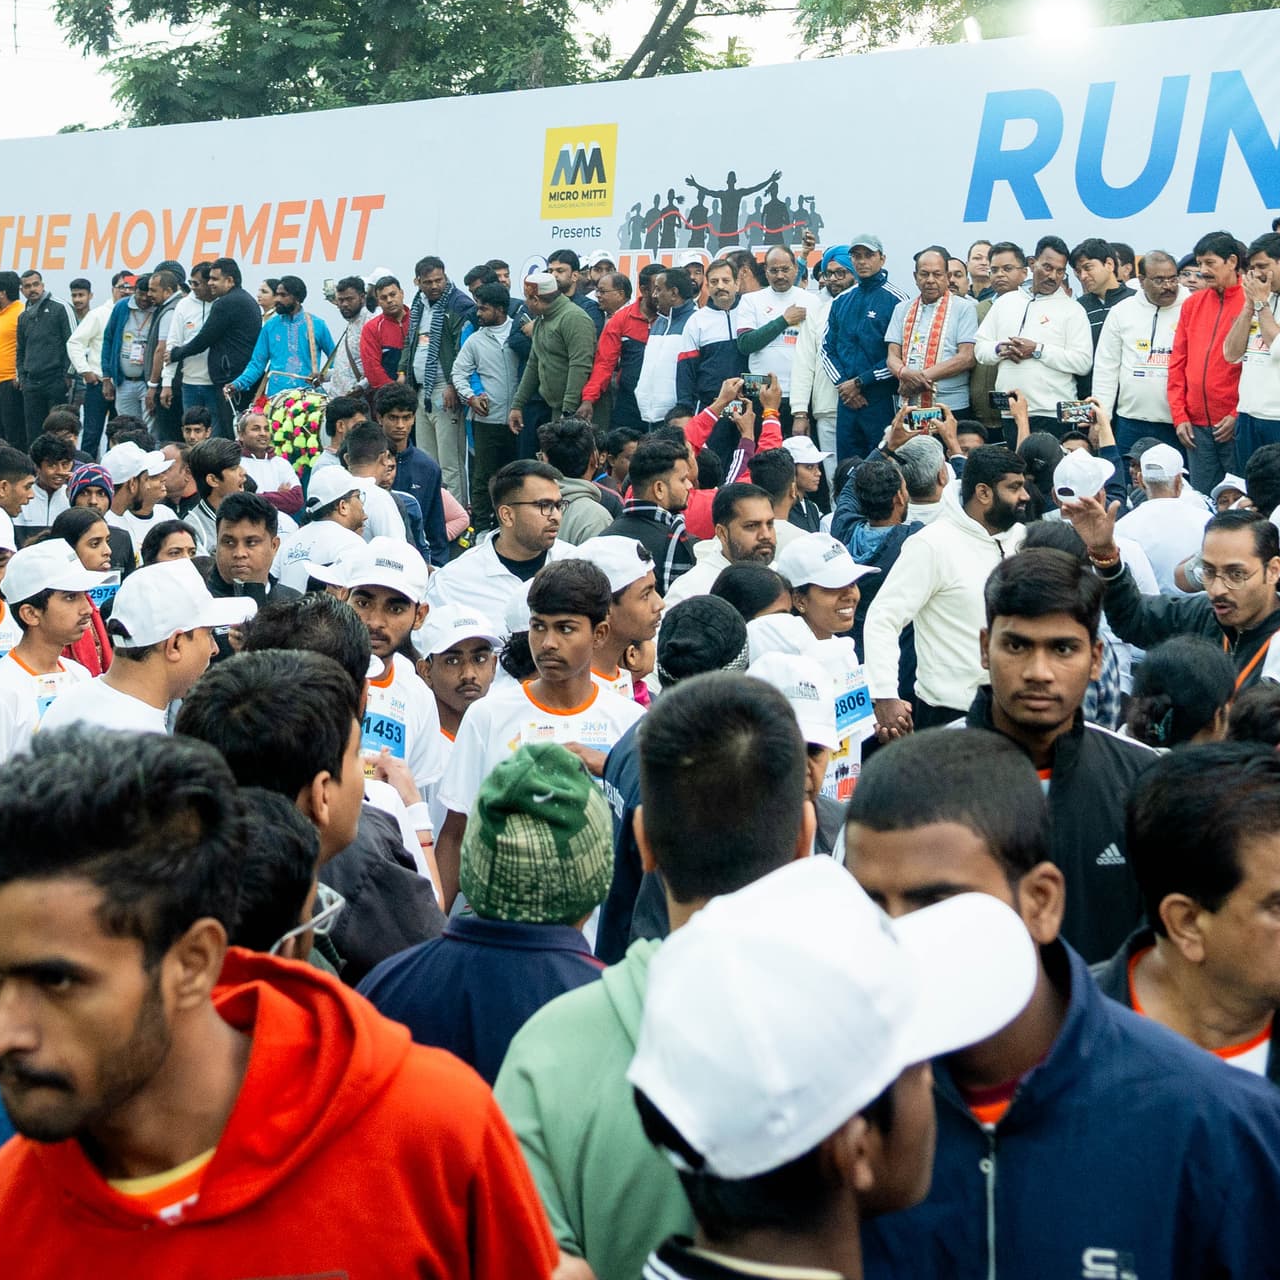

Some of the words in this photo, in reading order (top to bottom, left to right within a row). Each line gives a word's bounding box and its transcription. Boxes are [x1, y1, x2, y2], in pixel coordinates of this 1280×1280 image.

[549, 191, 579, 201] MICRO
[581, 189, 607, 200] MITTI
[81, 194, 386, 270] MOVEMENT
[551, 225, 601, 239] Presents
